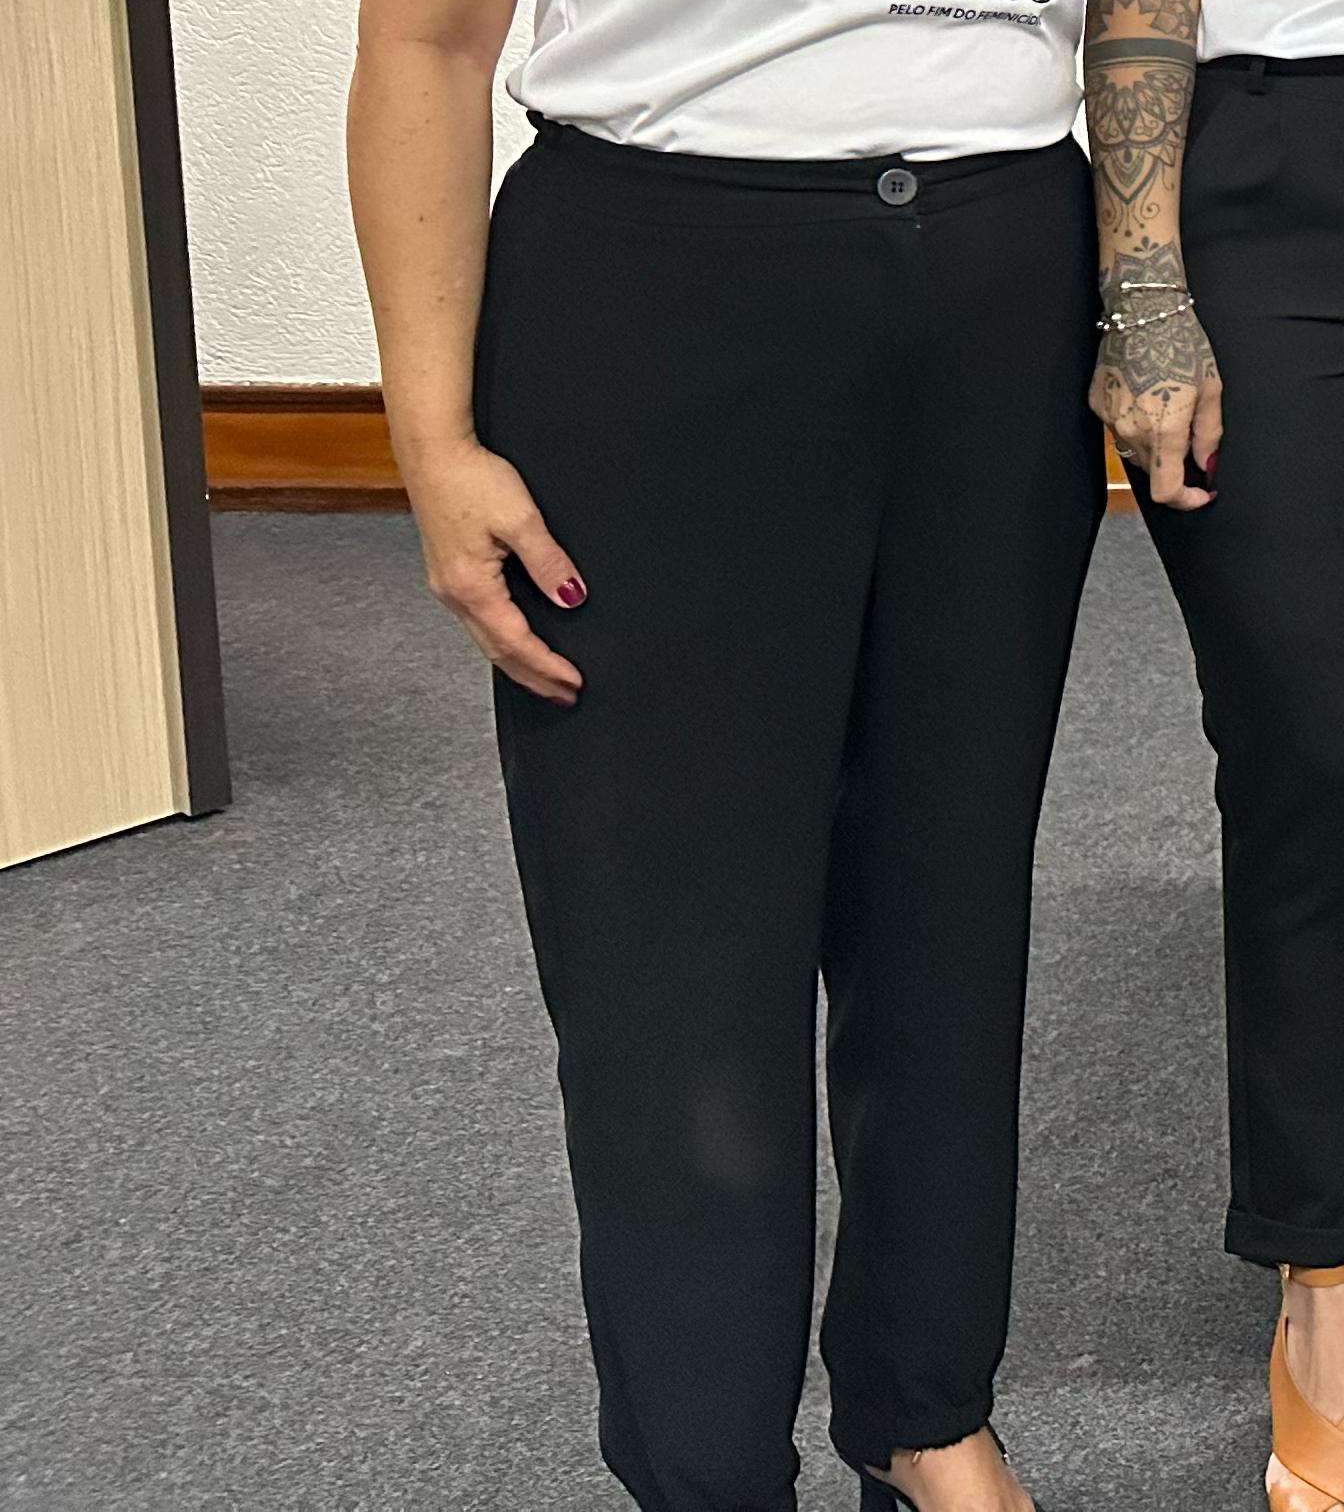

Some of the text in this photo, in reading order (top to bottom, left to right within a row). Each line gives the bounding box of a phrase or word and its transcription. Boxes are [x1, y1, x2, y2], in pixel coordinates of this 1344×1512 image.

[888, 3, 926, 15] PELO
[926, 5, 952, 17] FIM
[953, 8, 977, 20] DO
